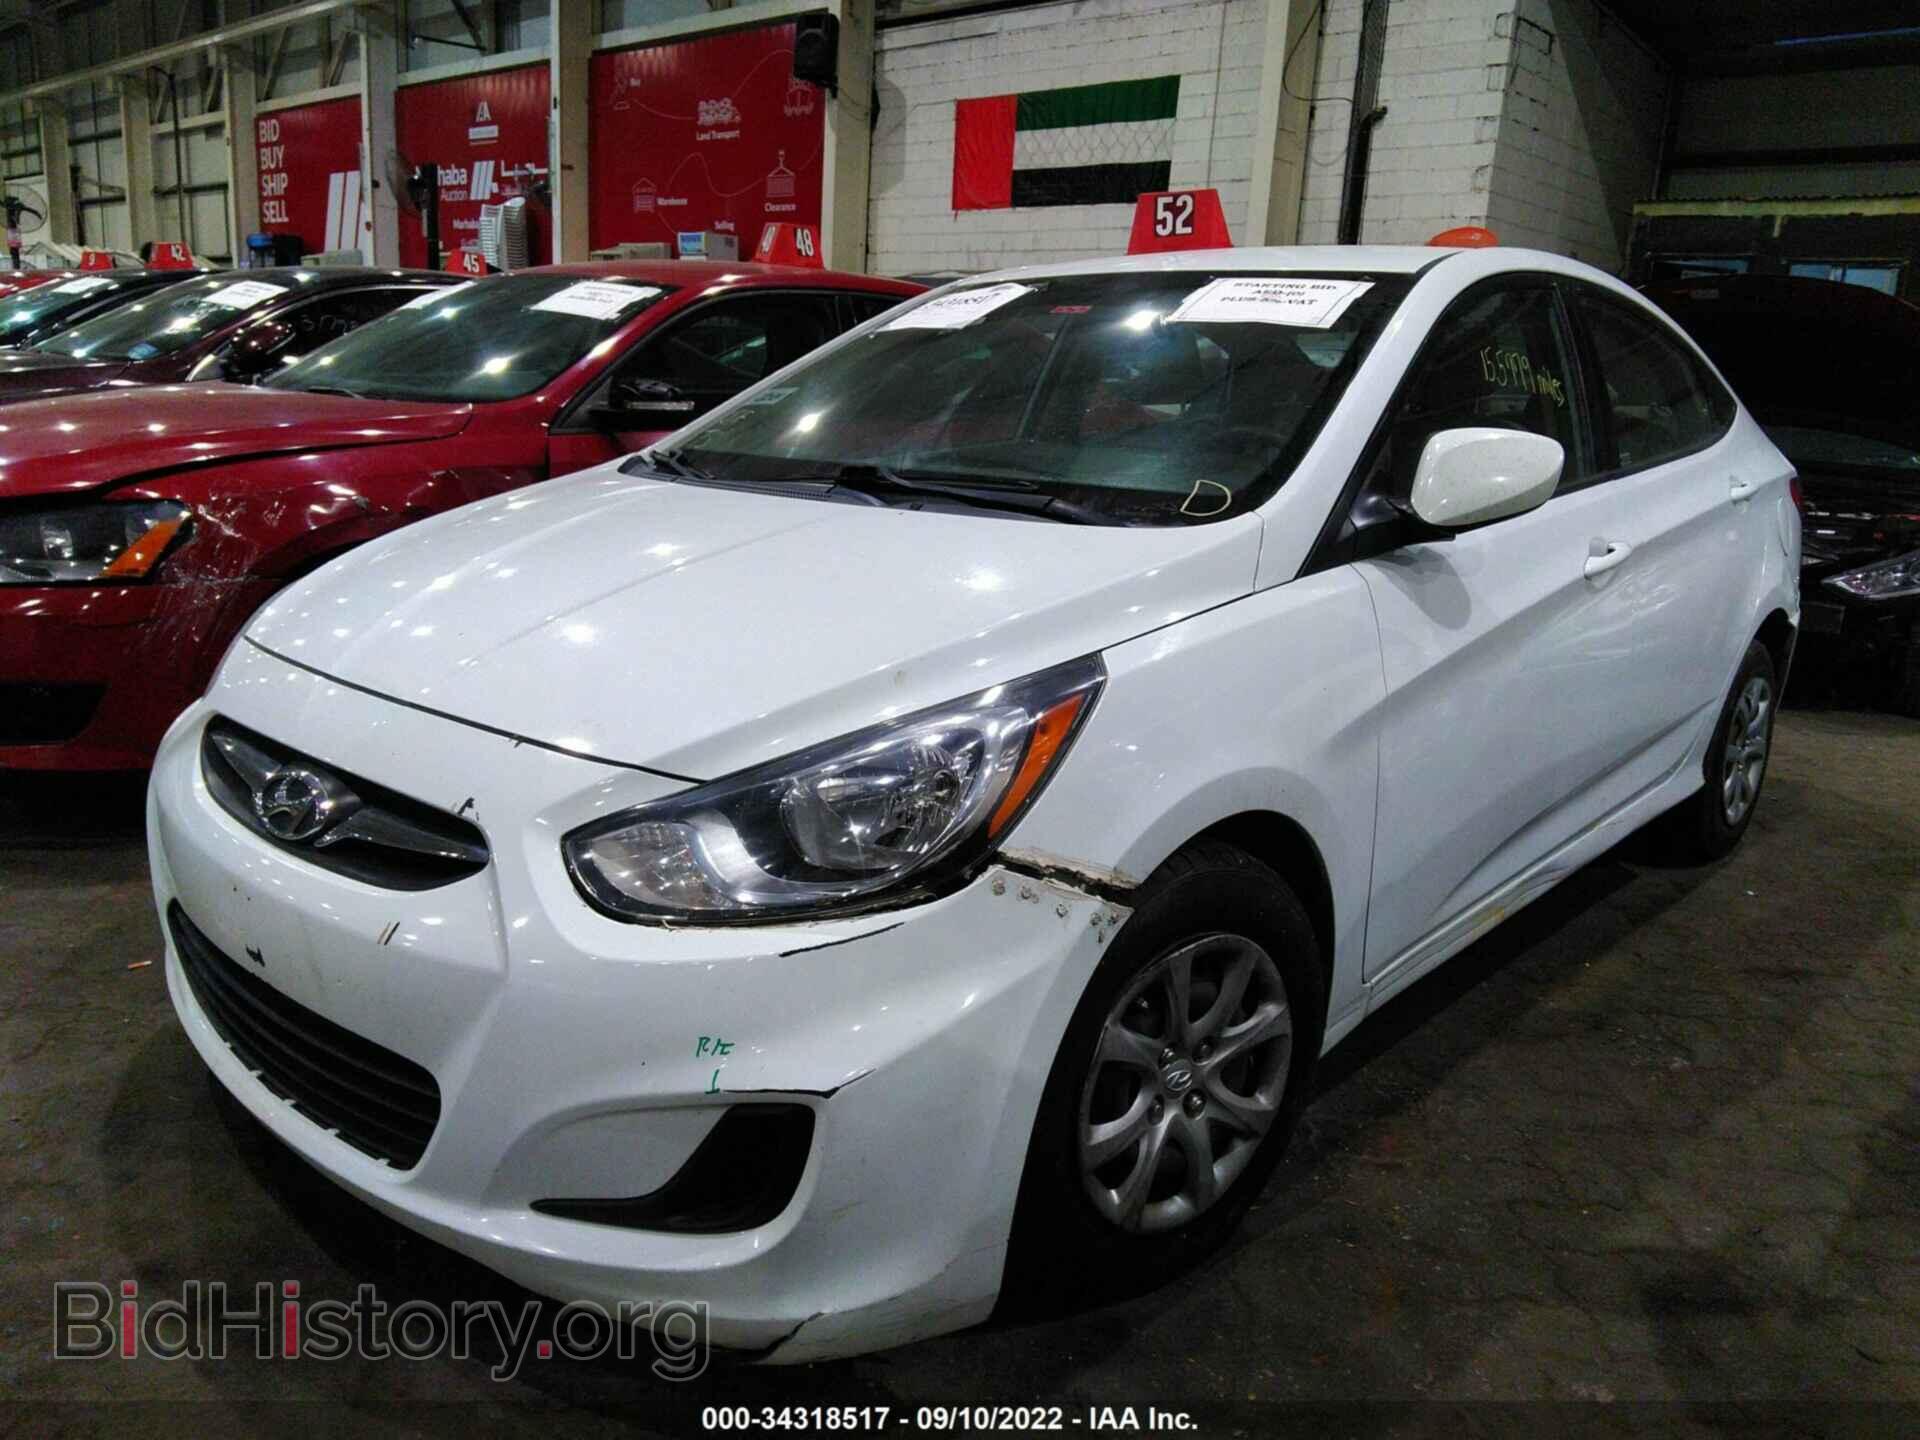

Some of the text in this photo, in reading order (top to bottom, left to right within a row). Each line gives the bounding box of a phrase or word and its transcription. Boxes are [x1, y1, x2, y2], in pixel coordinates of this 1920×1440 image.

[258, 118, 280, 142] BID
[260, 144, 285, 170] BUY
[261, 172, 289, 197] SHIP
[440, 188, 469, 202] Auction
[262, 199, 290, 223] SELL
[764, 201, 797, 213] Clearance
[1153, 194, 1194, 237] 52
[795, 227, 814, 257] 48
[462, 253, 480, 273] 45
